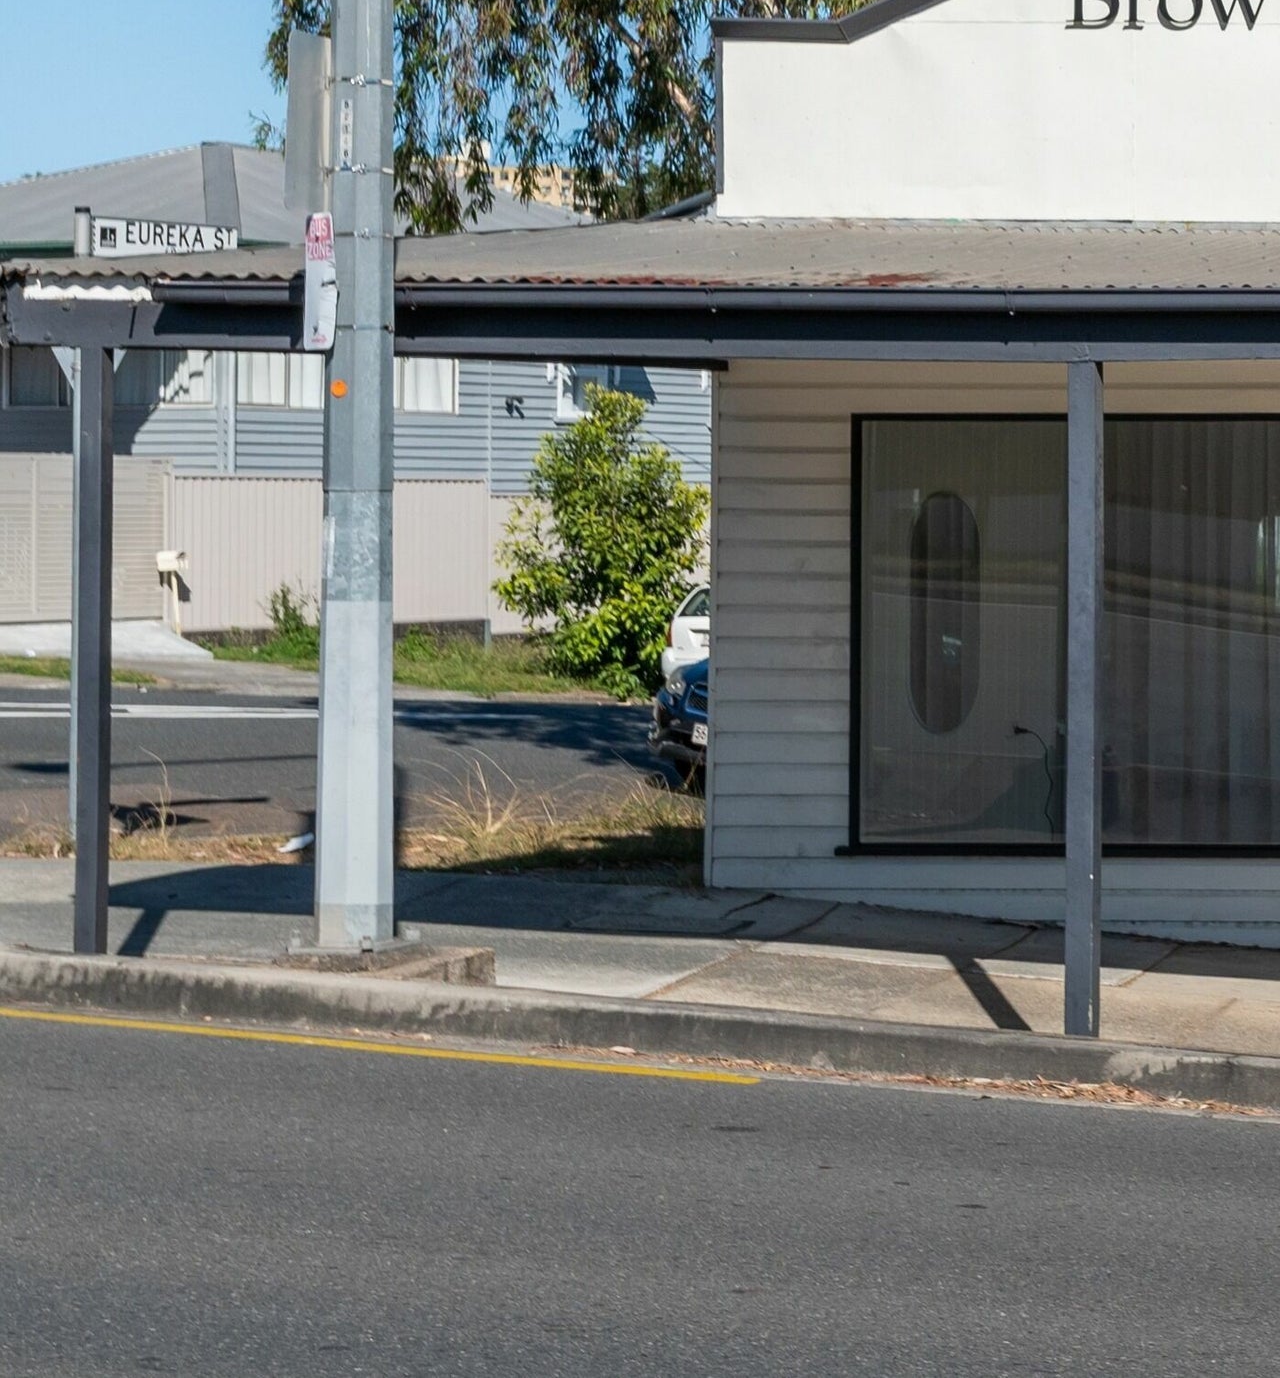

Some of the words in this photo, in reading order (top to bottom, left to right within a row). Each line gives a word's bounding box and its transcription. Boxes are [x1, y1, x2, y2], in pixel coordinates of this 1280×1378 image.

[125, 220, 205, 249] EUREKA
[213, 226, 238, 251] ST
[309, 217, 329, 236] BUS
[307, 241, 333, 260] ZONE
